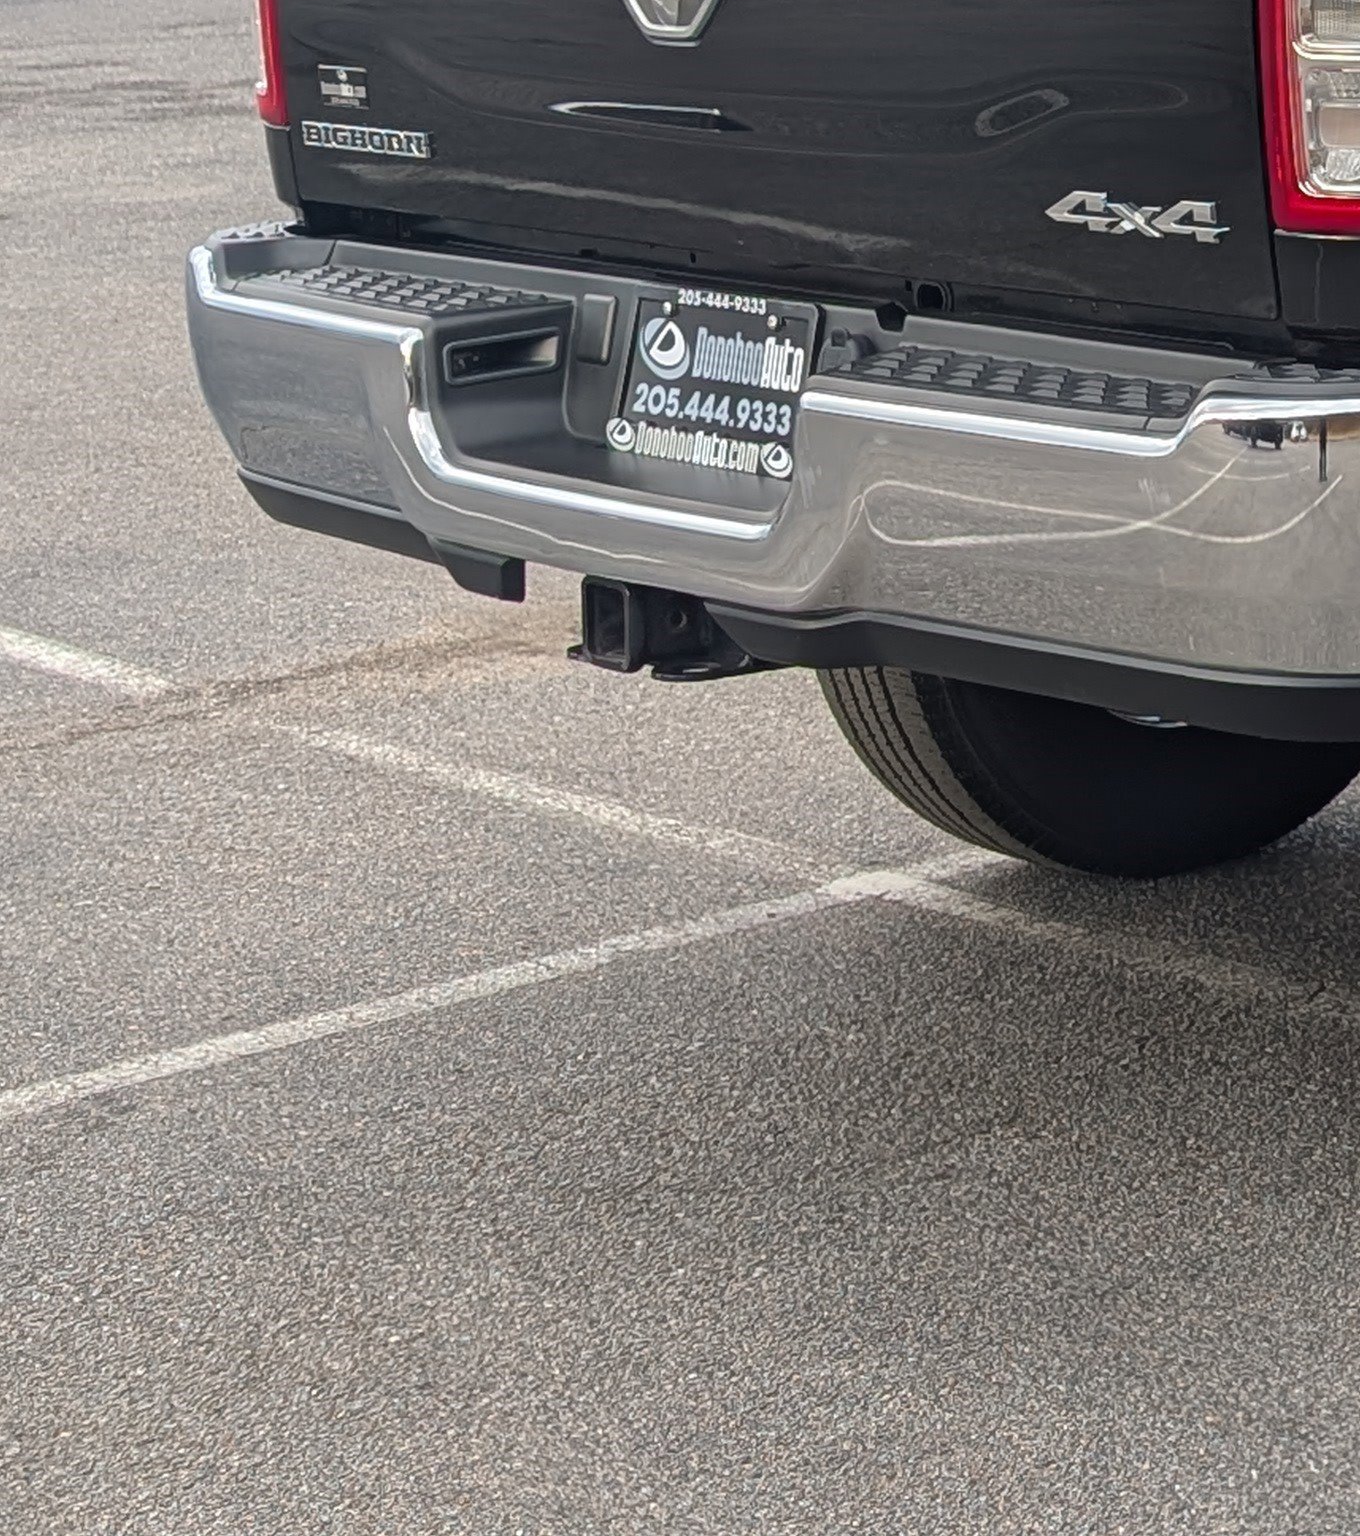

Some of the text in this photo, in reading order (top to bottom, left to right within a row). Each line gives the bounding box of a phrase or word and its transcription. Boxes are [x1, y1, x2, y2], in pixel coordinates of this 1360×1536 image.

[302, 121, 430, 157] BIGHORN
[678, 288, 767, 315] 205-444-9333
[632, 382, 792, 436] 205.444.9333
[634, 421, 761, 475] DonohooAuto.com
